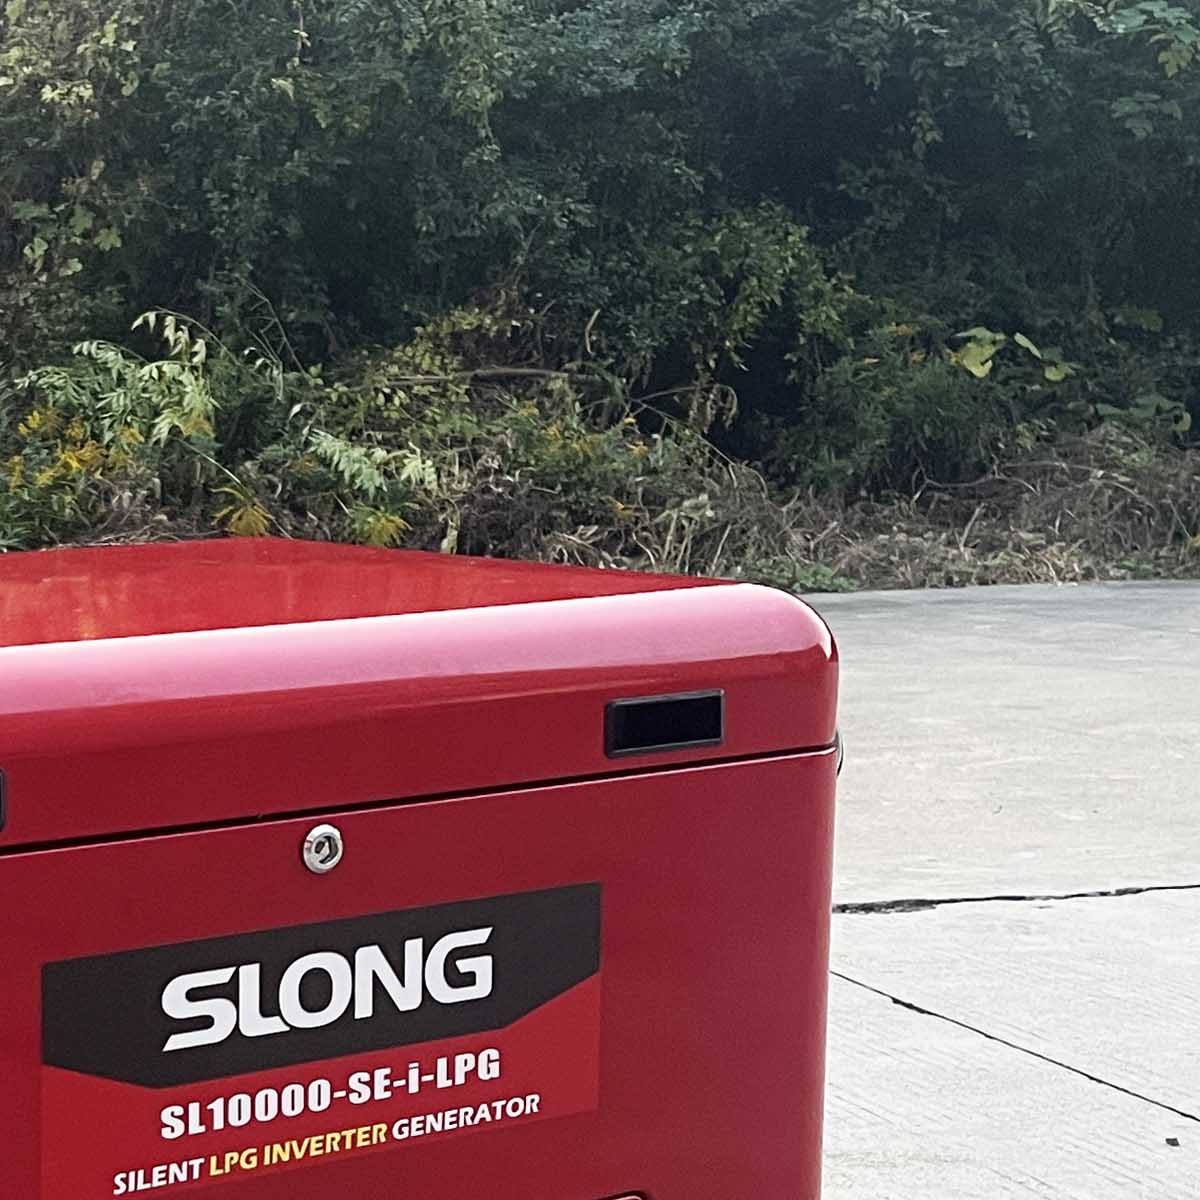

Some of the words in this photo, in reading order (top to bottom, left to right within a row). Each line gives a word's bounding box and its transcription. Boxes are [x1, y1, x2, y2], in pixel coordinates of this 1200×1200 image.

[161, 927, 494, 1052] SLONG
[112, 1157, 205, 1196] SILENT
[208, 1147, 258, 1177] LPG
[262, 1122, 388, 1166] INVERTER
[391, 1093, 541, 1141] GENERATOR
[160, 1048, 501, 1140] SL10000-SE-i-LPG
